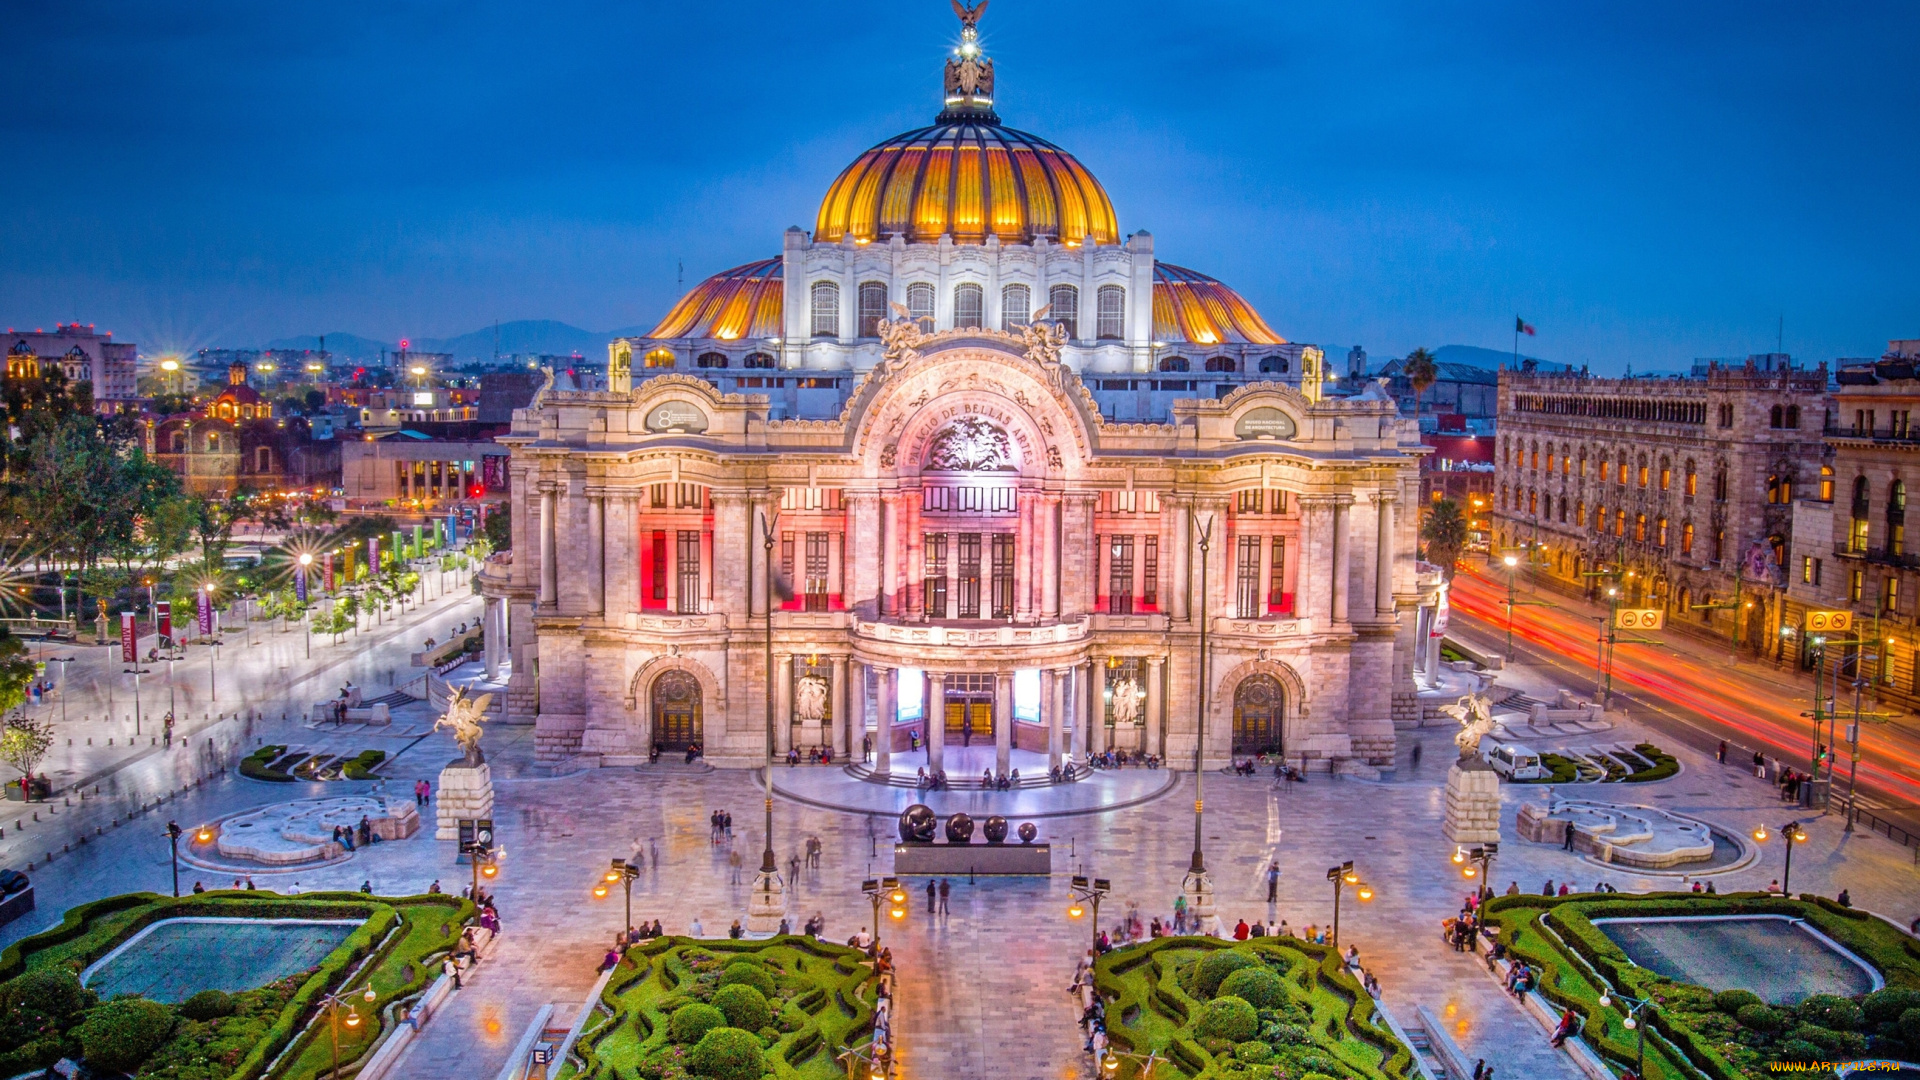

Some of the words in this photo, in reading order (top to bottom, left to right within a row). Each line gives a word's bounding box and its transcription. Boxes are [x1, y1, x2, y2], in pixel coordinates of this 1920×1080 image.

[909, 418, 939, 465] PALACIO
[942, 406, 958, 420] DE
[964, 404, 1013, 426] BELLAS
[1012, 428, 1034, 466] ARTES
[199, 605, 209, 634] DANZA
[122, 627, 132, 662] MUSICA
[535, 1051, 545, 1062] E
